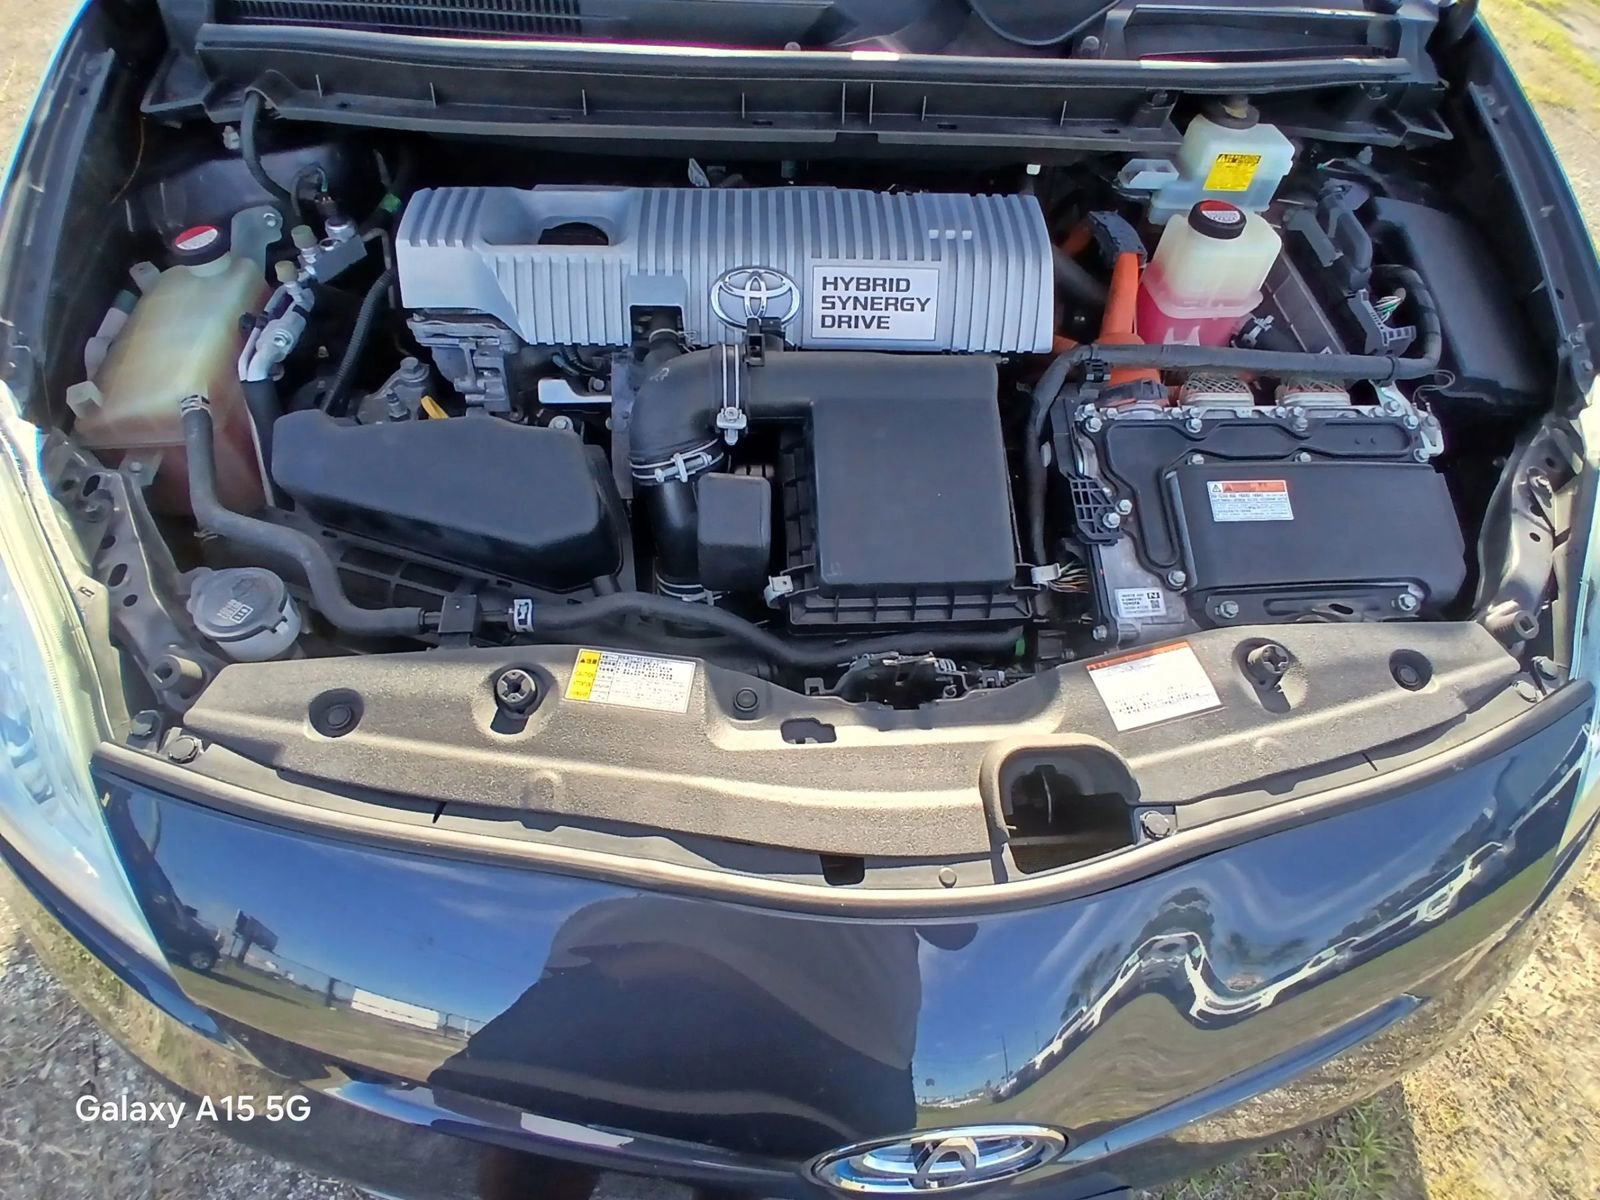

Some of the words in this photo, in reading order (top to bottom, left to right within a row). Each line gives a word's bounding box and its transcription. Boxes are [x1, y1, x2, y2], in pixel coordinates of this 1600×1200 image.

[822, 276, 911, 293] HYBRID
[821, 295, 931, 312] SYNERGY
[821, 314, 891, 330] DRIVE
